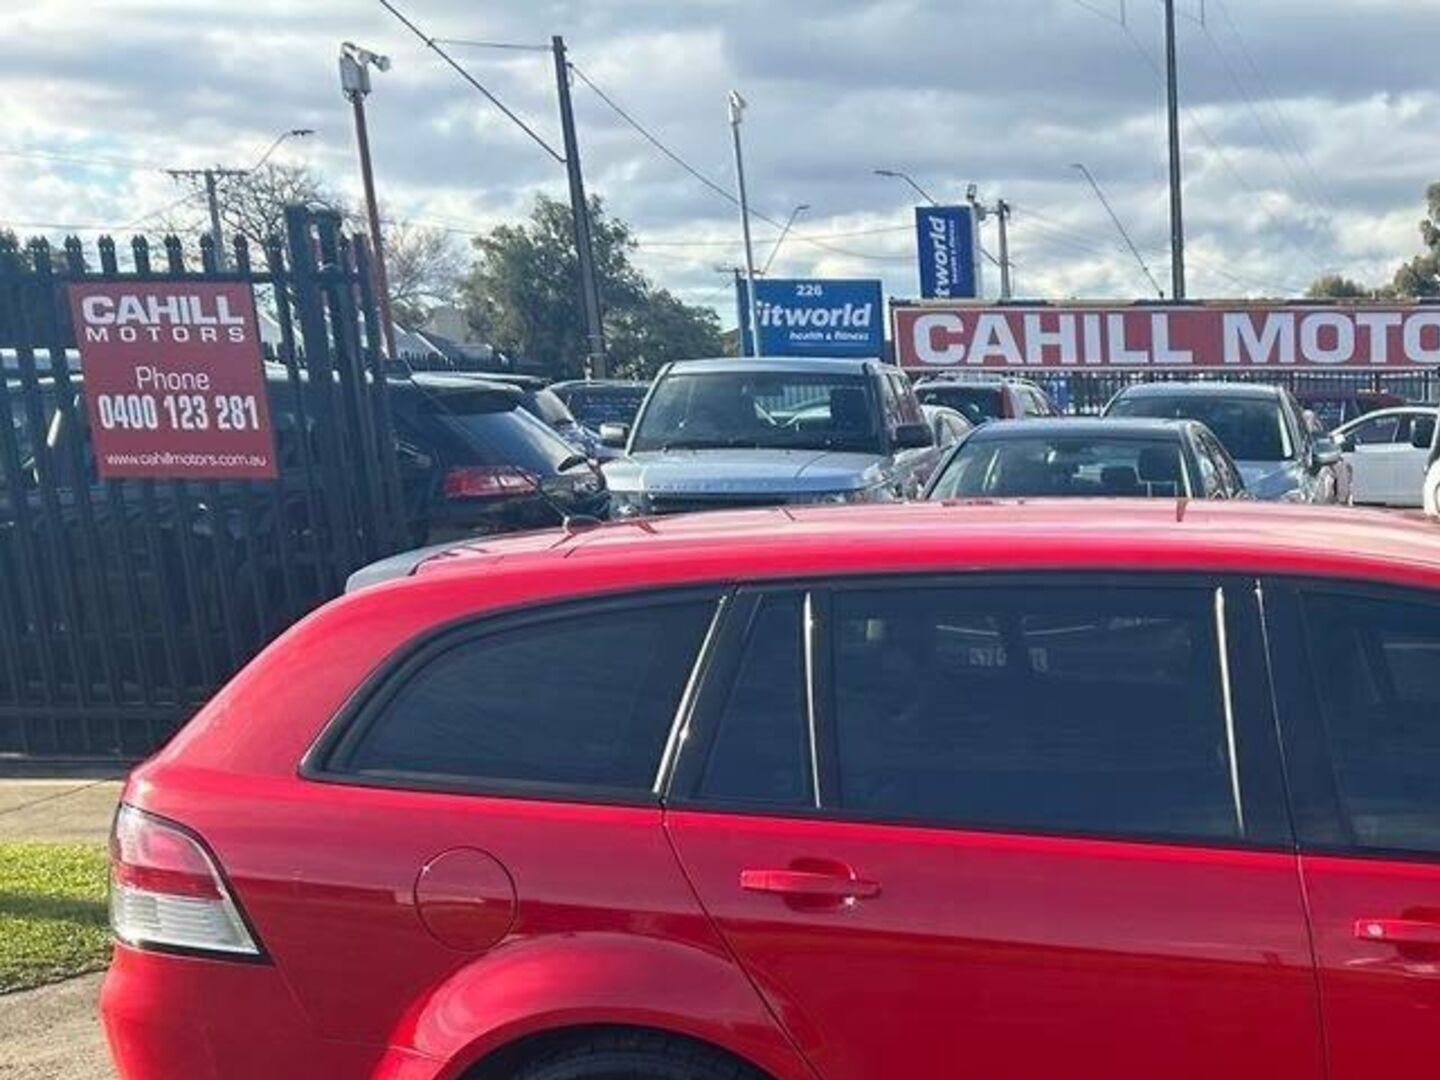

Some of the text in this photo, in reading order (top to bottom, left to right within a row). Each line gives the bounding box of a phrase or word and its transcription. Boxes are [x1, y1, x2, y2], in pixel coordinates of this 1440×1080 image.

[928, 215, 950, 298] tworld
[796, 284, 823, 296] 226
[82, 295, 245, 325] CAHILL
[86, 326, 246, 343] MOTORS
[912, 312, 1194, 365] CAHILL
[135, 366, 210, 390] Phone
[98, 394, 260, 431] 0400 123 281
[106, 452, 266, 467] www.cahillmotors.com.au
